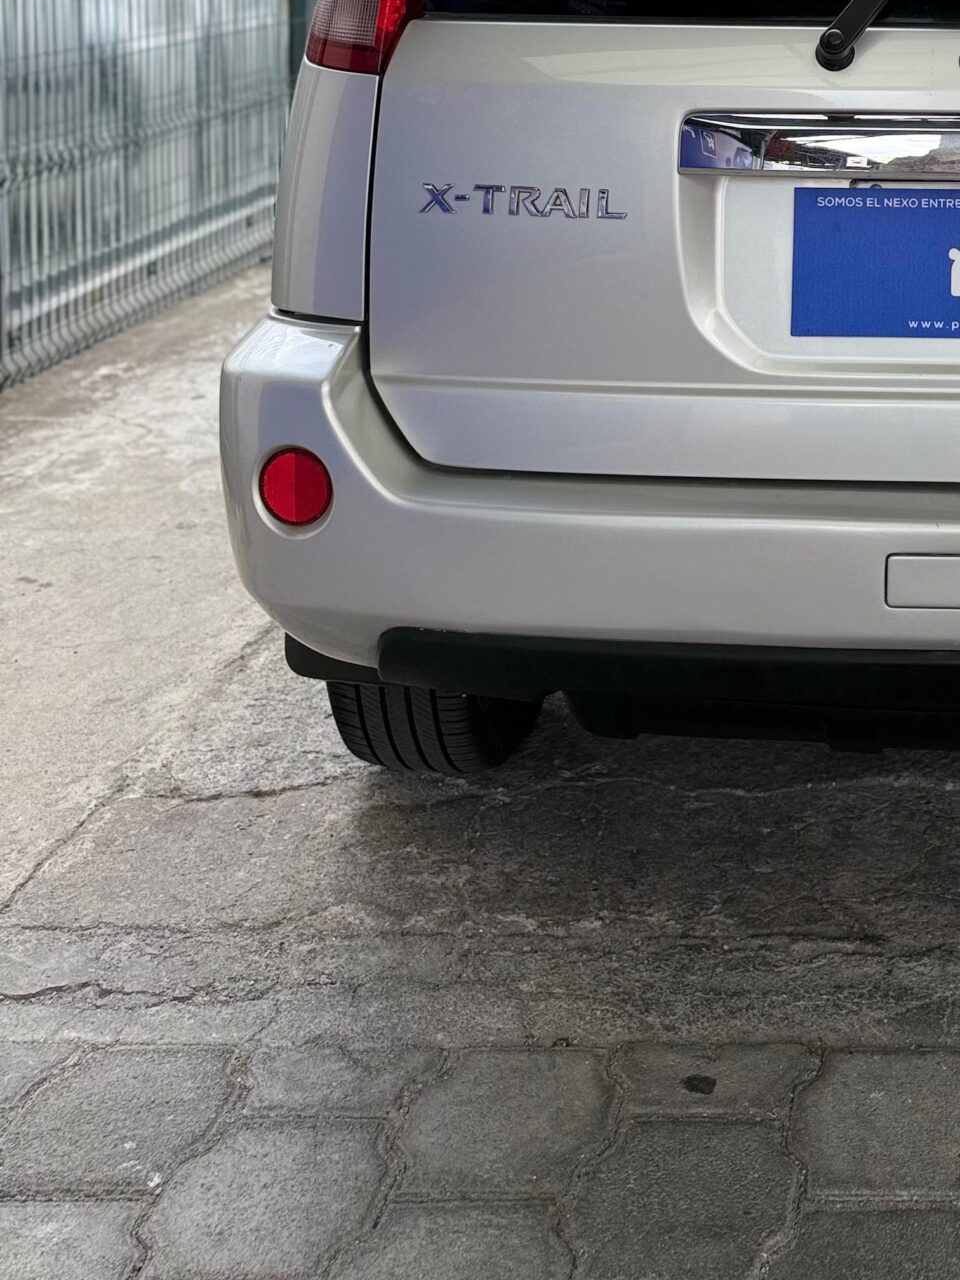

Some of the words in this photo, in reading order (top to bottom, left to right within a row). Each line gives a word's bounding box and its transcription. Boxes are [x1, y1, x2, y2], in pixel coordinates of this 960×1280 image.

[418, 183, 628, 220] X-TRAIL
[816, 196, 863, 207] SOMOS
[866, 197, 881, 208] EL
[884, 197, 919, 208] NEXO
